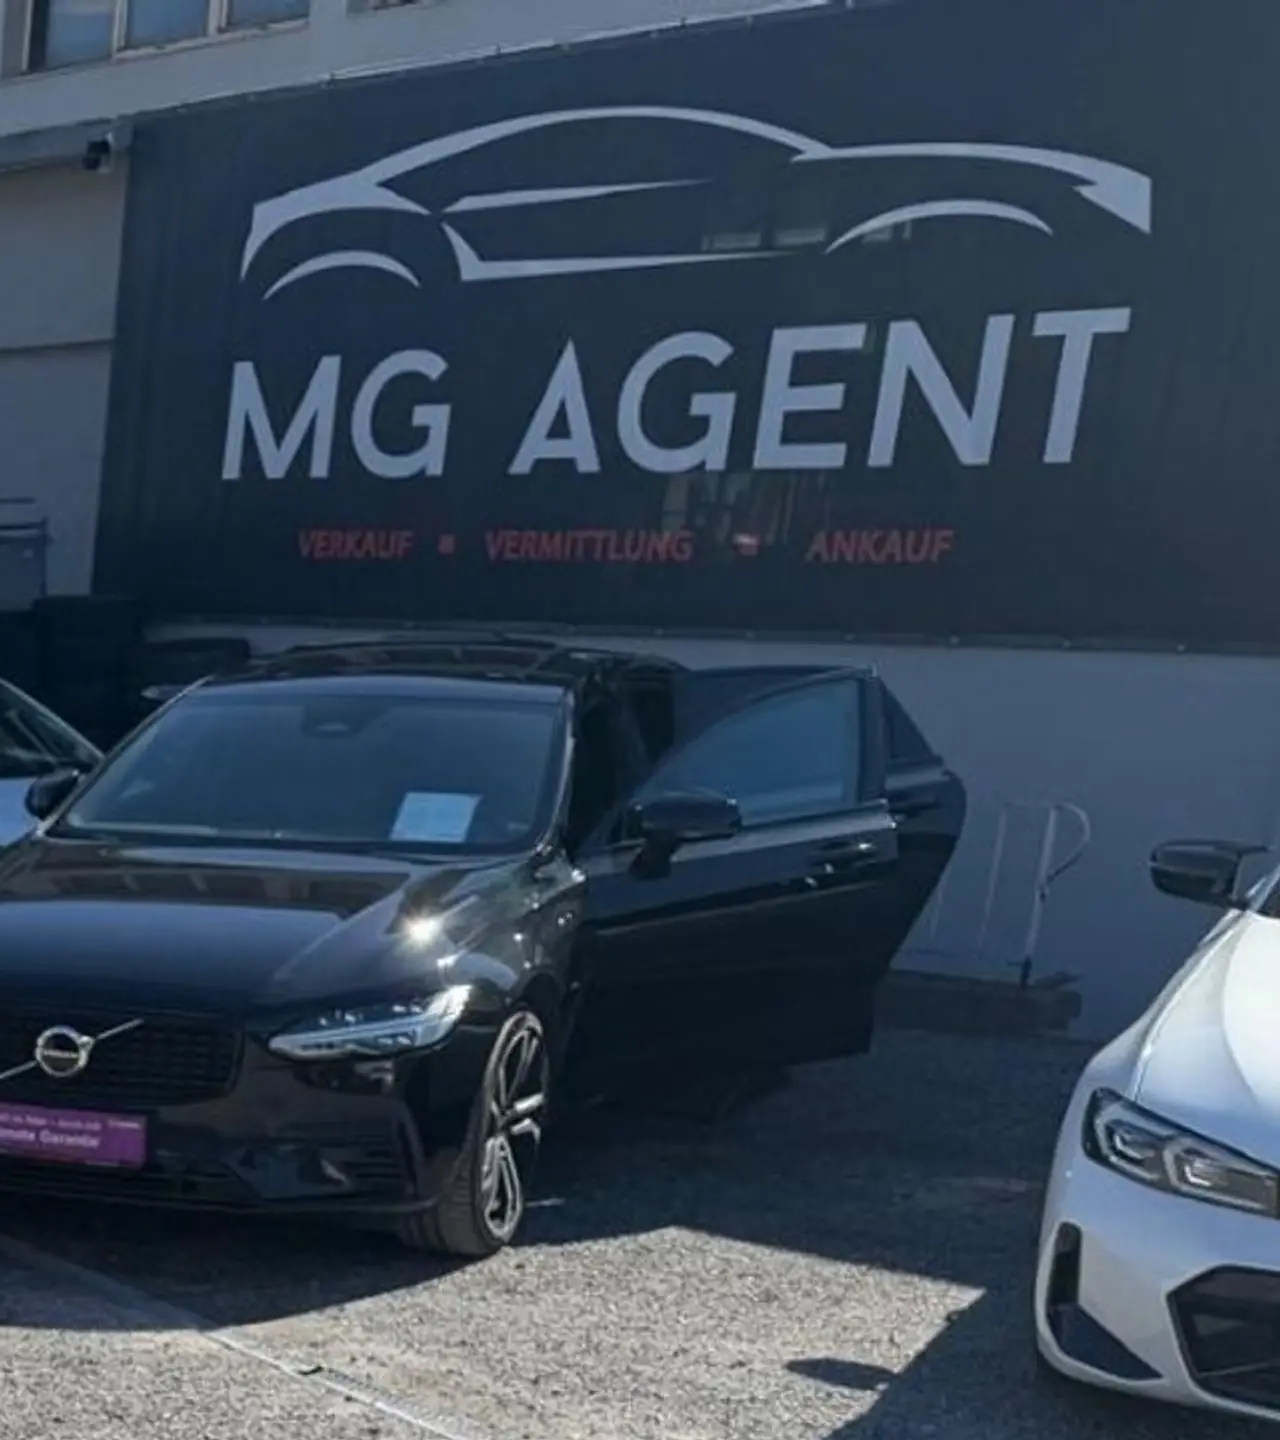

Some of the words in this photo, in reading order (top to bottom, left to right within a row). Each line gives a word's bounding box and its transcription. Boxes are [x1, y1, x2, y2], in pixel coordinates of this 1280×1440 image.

[222, 350, 450, 480] MG
[510, 307, 1131, 475] AGENT
[297, 529, 415, 560] VERKAUF
[484, 528, 694, 563] VERMITTLUNG
[804, 528, 955, 564] ANKAUF
